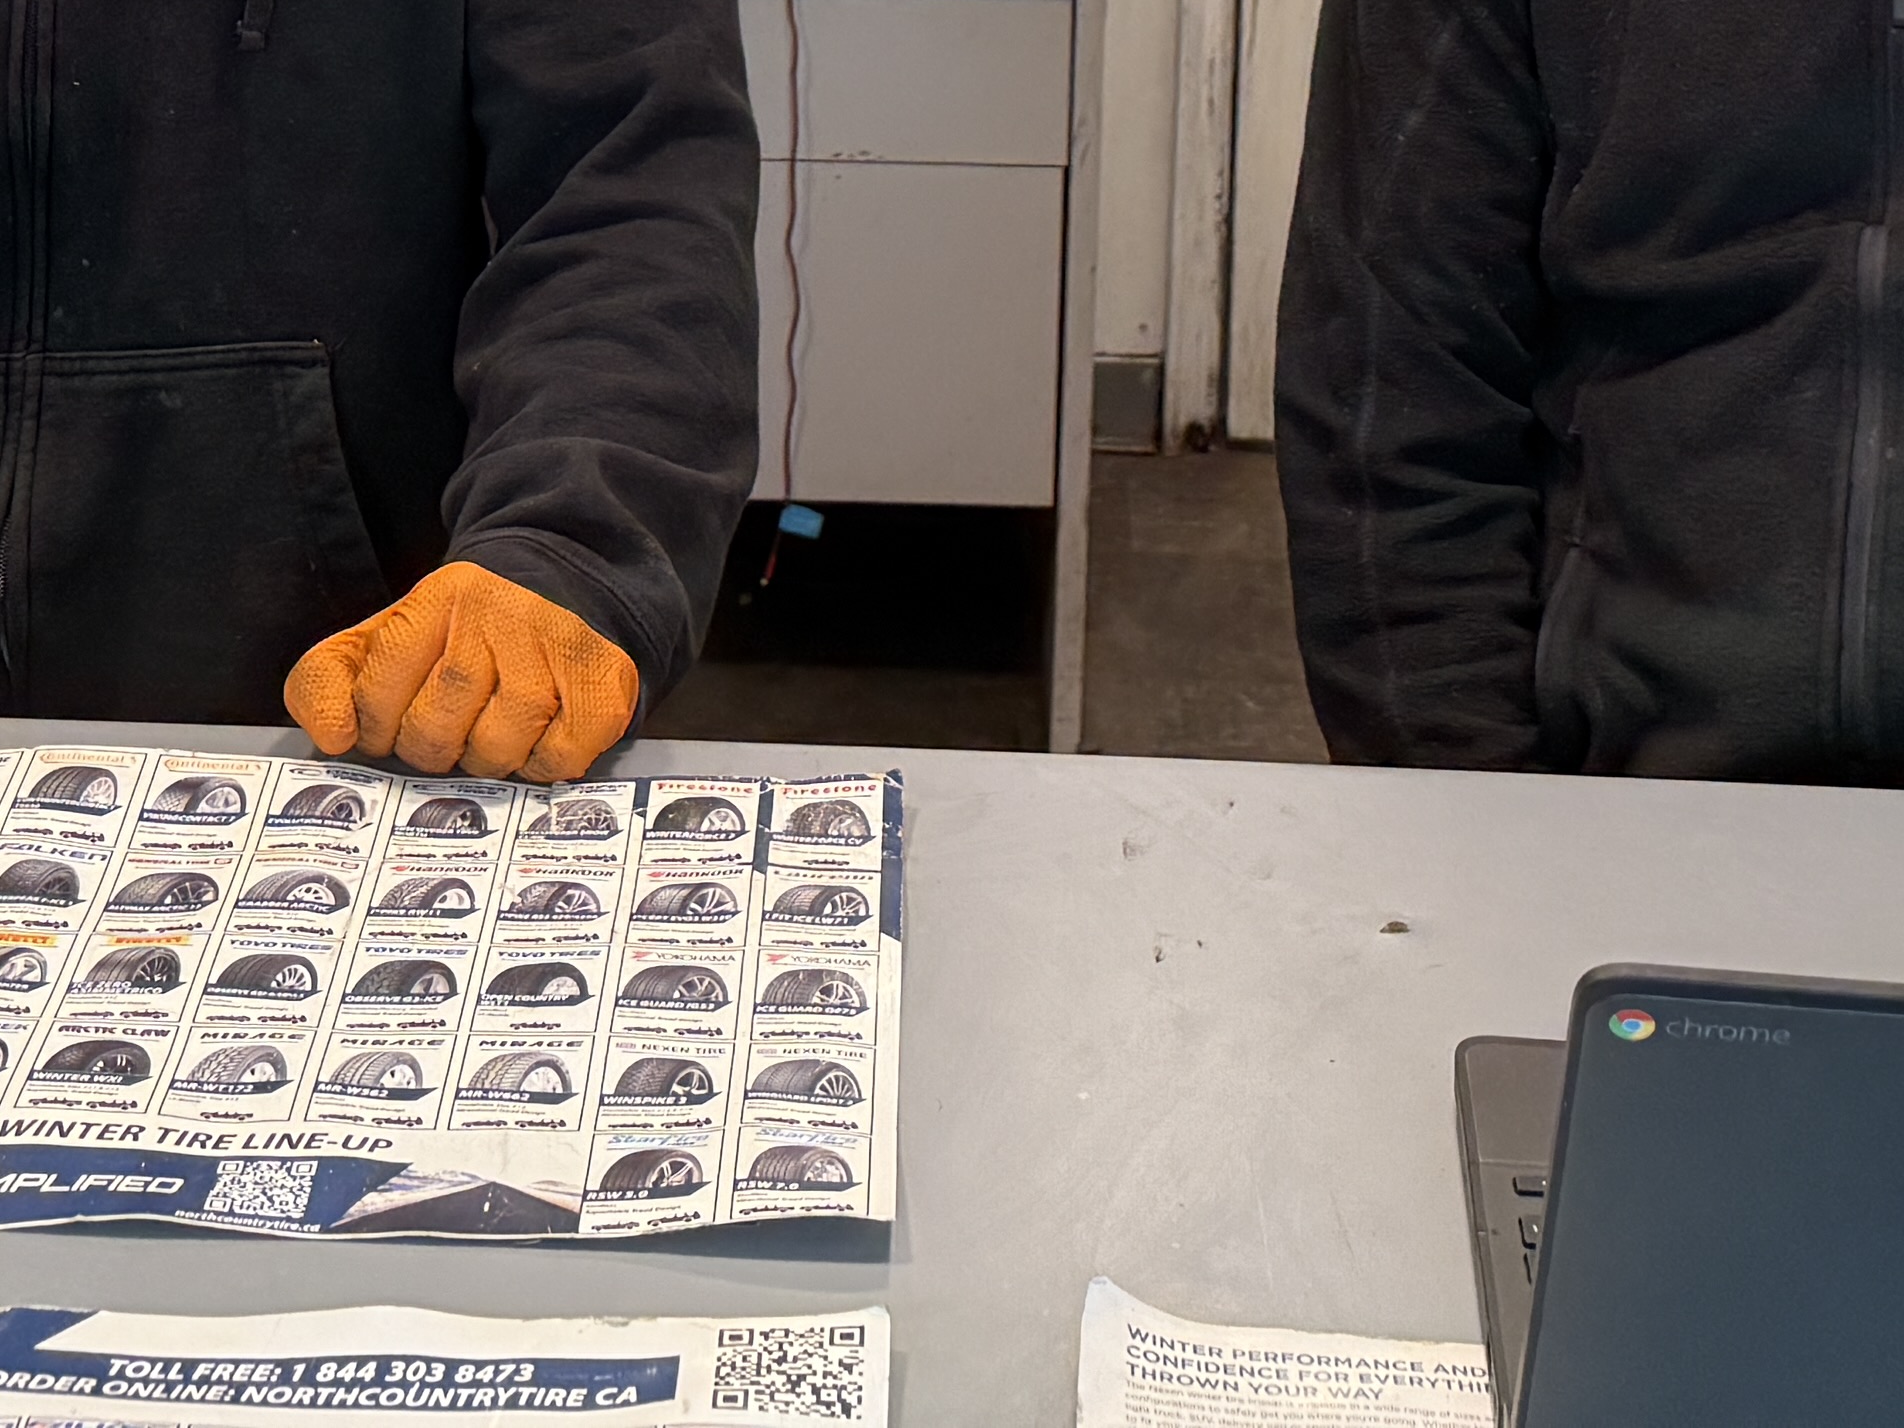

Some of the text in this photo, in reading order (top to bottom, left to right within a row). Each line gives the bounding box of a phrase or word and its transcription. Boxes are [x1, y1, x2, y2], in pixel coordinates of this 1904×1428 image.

[657, 782, 755, 794] Firestone
[781, 784, 877, 795] Firestone
[0, 843, 108, 862] FALKEN
[283, 941, 334, 950] TIRES
[417, 948, 468, 956] TIRES
[549, 950, 601, 958] TIRES
[656, 952, 736, 962] YOKOHAMA
[791, 955, 871, 967] YOKOHAMA
[617, 999, 683, 1009] ICE GUARD
[756, 1005, 776, 1013] ICE
[122, 1026, 171, 1037] CLAW
[1665, 1016, 1791, 1044] chrome
[200, 1032, 306, 1041] MIRAGE
[340, 1038, 445, 1047] MIRAGE
[479, 1040, 584, 1048] MIRAGE
[642, 1044, 726, 1055] NEXEN TIRE
[783, 1047, 867, 1059] NEXEN TIRE
[32, 1071, 93, 1081] WINTER
[603, 1095, 677, 1106] WINSPIKE
[155, 1126, 240, 1150] TIRE
[244, 1131, 393, 1153] LINE-UP
[175, 1208, 322, 1232] northcountrytire.ca
[1128, 1323, 1487, 1378] WINTER PERFORMANCE AND
[1127, 1345, 1289, 1381] CONFIDENCE
[1298, 1370, 1349, 1384] FOR
[107, 1359, 535, 1383] TOLL FREE: 1 844 303 8473
[1126, 1361, 1384, 1401] THROWN YOUR WAY
[102, 1380, 234, 1403] ONLINE:
[240, 1385, 588, 1408] NORTHCOUNTRYTIRE
[595, 1386, 637, 1405] CA
